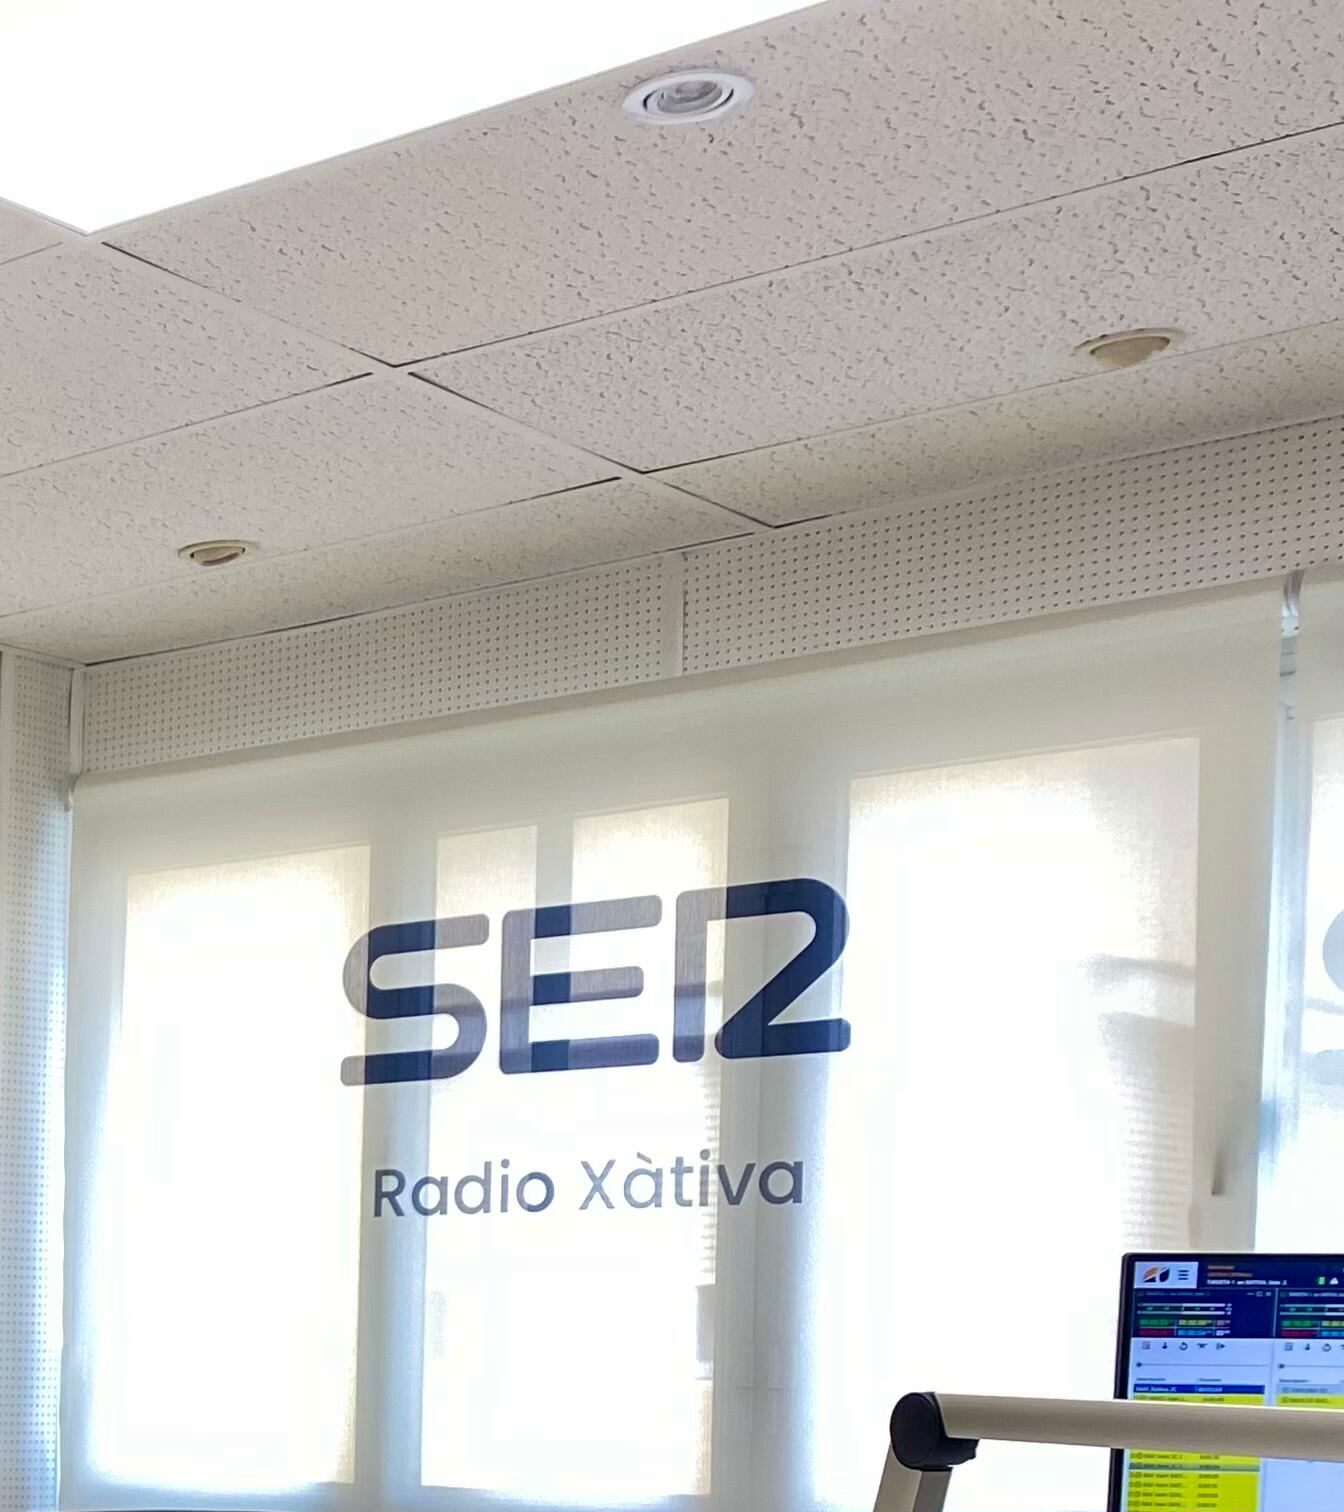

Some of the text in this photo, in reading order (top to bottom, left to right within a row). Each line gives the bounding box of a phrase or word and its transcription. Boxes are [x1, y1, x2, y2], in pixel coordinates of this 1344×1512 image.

[340, 877, 852, 1087] SER
[373, 1149, 806, 1218] Radio Xàtiva
